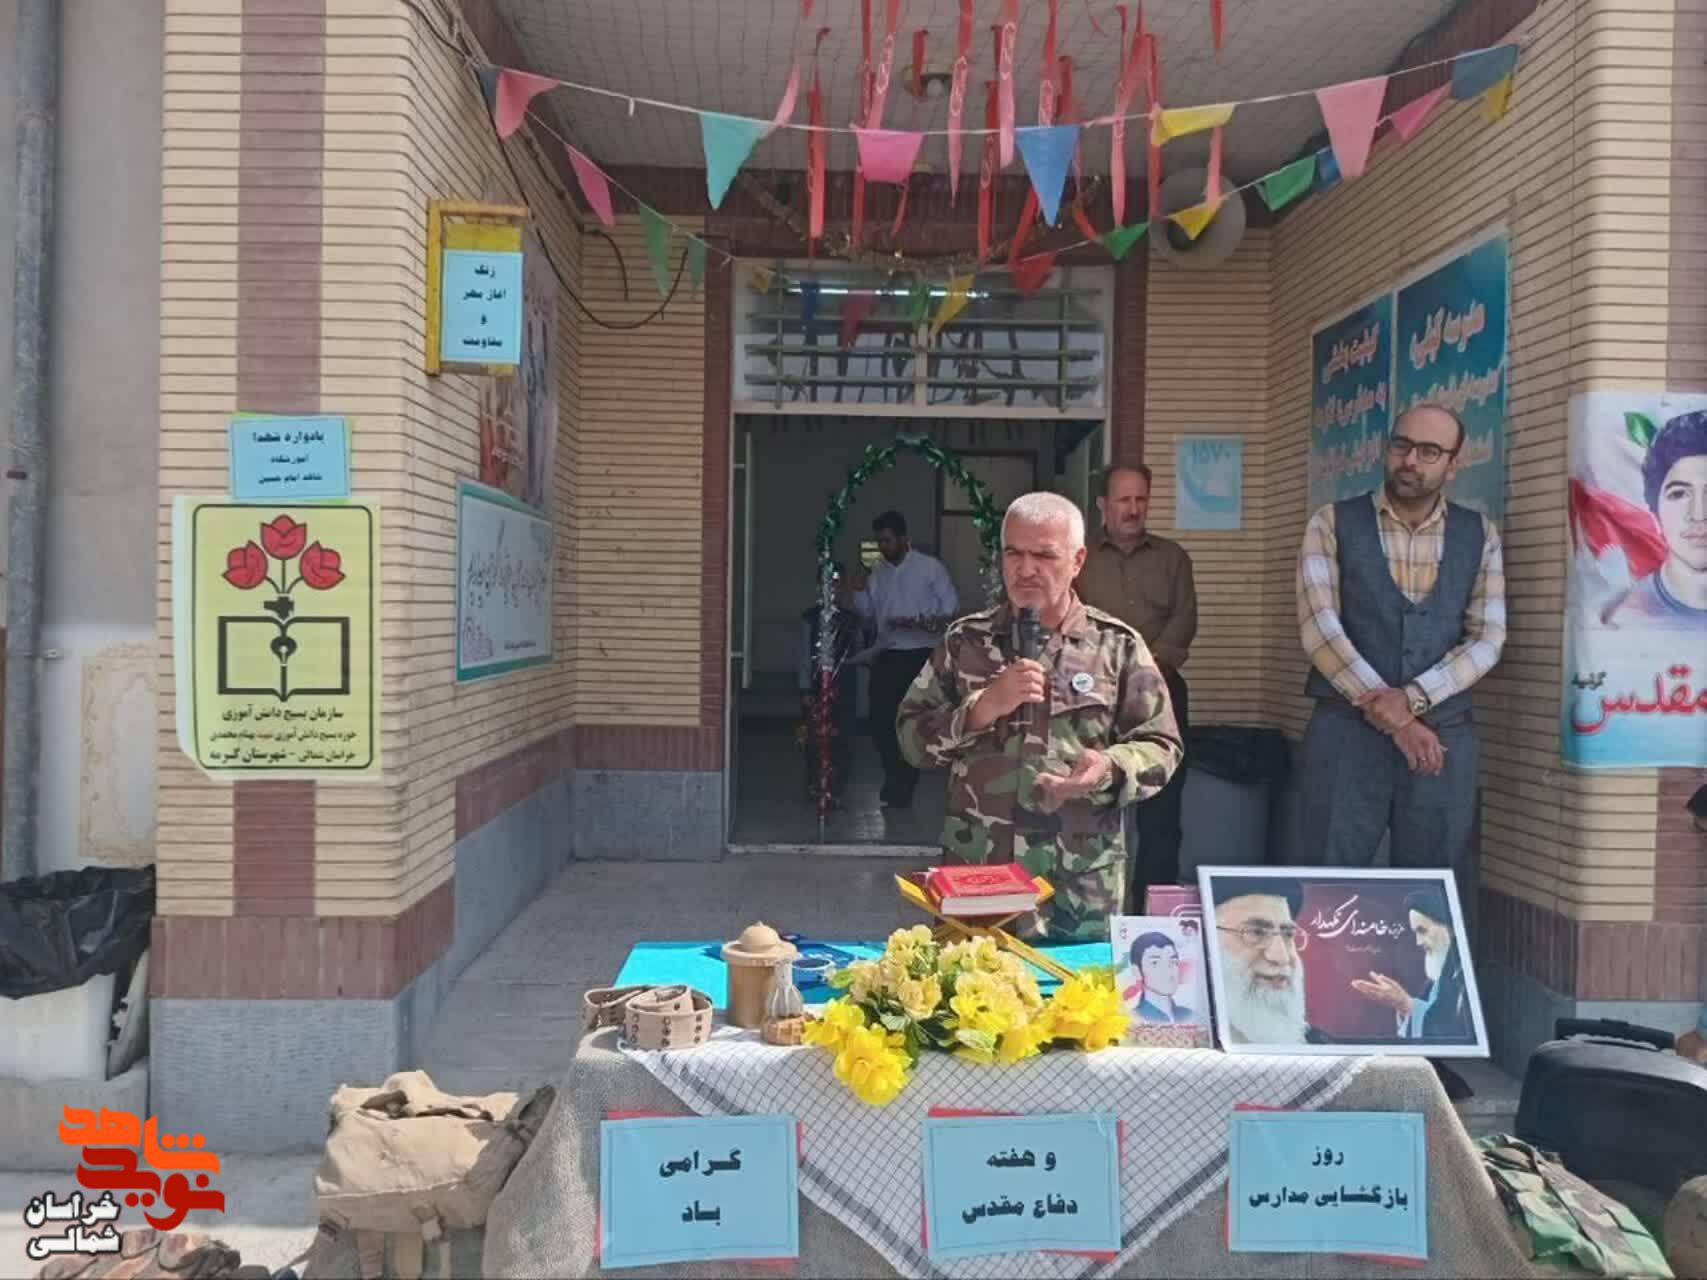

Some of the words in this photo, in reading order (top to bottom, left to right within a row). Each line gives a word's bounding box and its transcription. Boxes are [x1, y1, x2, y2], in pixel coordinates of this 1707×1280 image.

[480, 314, 487, 325] و
[255, 706, 282, 722] دانش
[283, 709, 307, 722] بسیج
[309, 706, 344, 722] سازمان
[241, 747, 287, 764] شهرستان
[986, 1148, 1035, 1168] هفته
[1044, 1151, 1057, 1171] و
[1312, 1146, 1344, 1166] روز
[1033, 1193, 1079, 1219] دفاع
[1248, 1187, 1309, 1208] مدارس
[681, 1200, 721, 1226] باد
[962, 1195, 1025, 1224] مقدس
